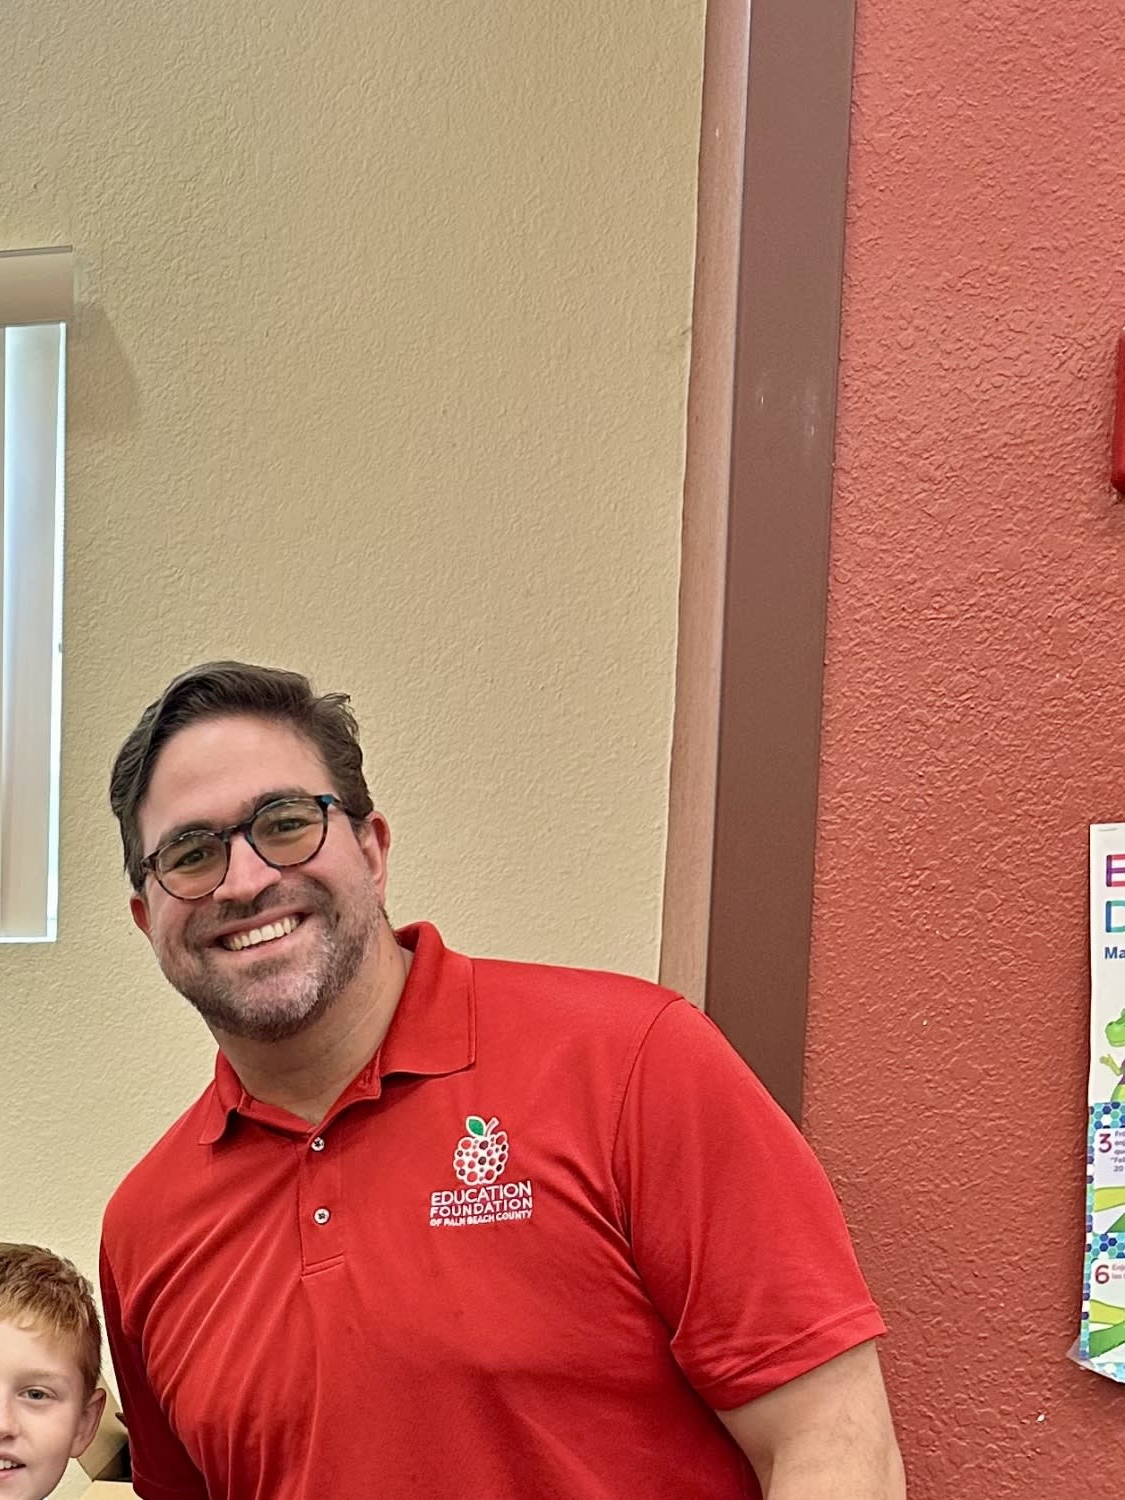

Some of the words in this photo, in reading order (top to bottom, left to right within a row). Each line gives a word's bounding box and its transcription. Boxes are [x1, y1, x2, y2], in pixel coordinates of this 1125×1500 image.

[1098, 1133, 1112, 1153] 3
[431, 1180, 532, 1206] EDUCATION
[429, 1218, 442, 1227] OF
[443, 1217, 465, 1226] PALM
[467, 1213, 494, 1225] BEACH
[495, 1209, 532, 1221] COUNTY
[430, 1197, 533, 1218] FOUNDATION
[1095, 1264, 1110, 1285] 6
